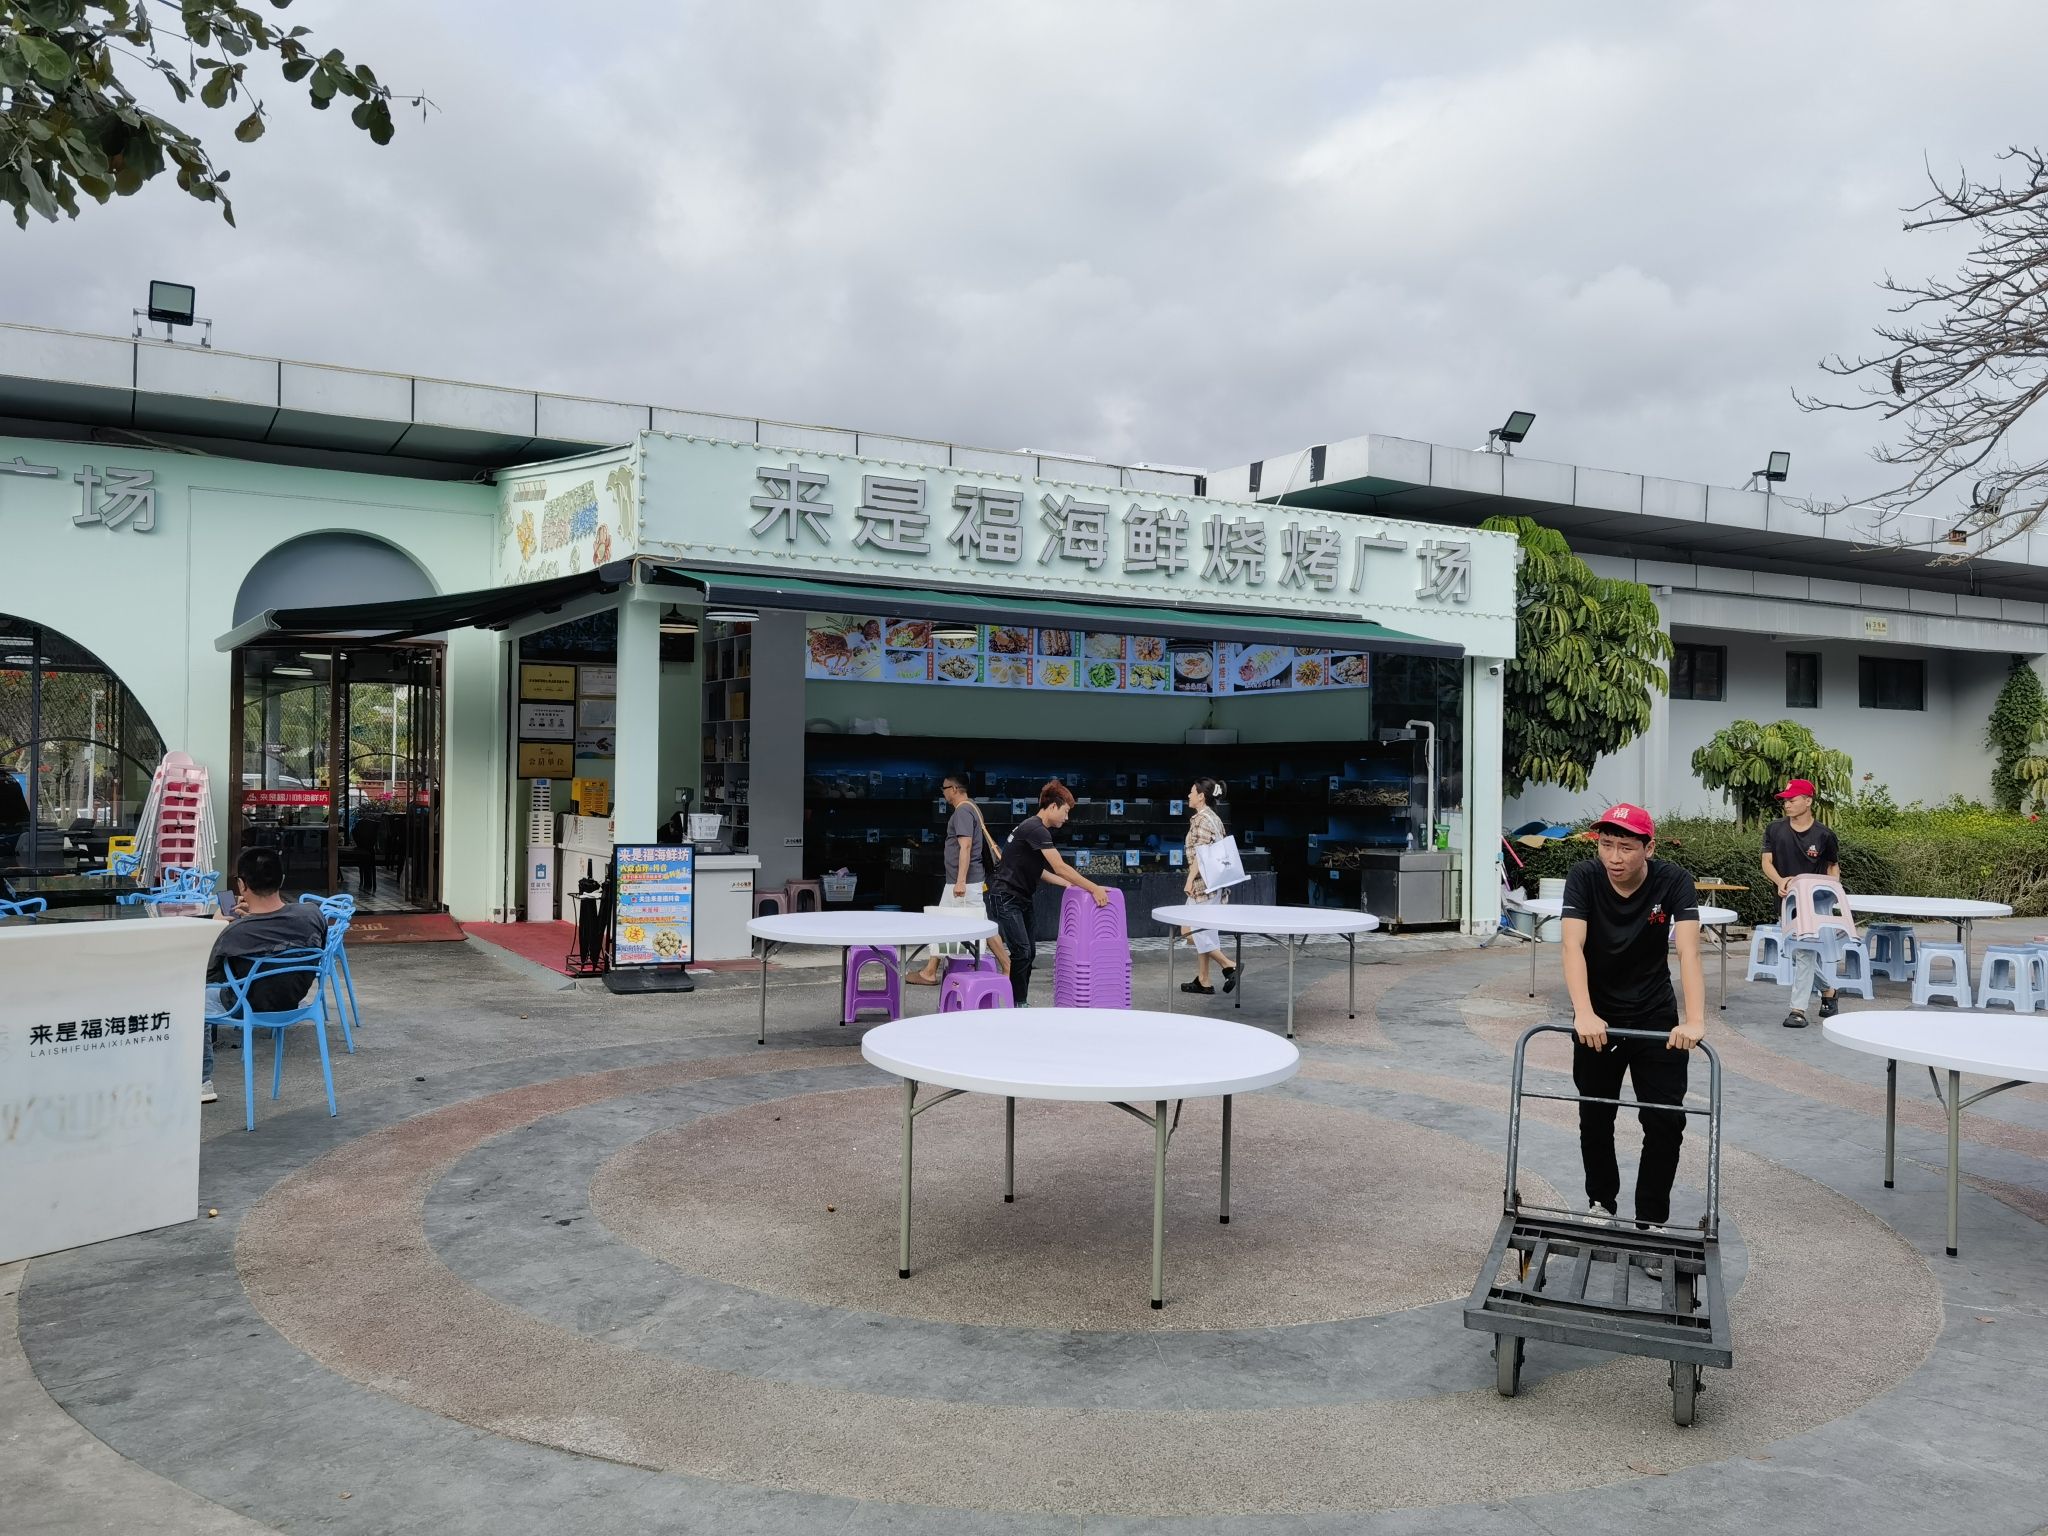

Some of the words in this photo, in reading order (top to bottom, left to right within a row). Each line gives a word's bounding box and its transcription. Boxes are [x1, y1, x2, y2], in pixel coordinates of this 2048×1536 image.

[750, 462, 1474, 604] 来是福海鲜烧烤广场
[619, 848, 690, 862] 来是福海鲜坊
[29, 1011, 171, 1046] 来是福海鲜坊
[30, 1034, 170, 1059] LAISHIFUHAIXIANFANG
